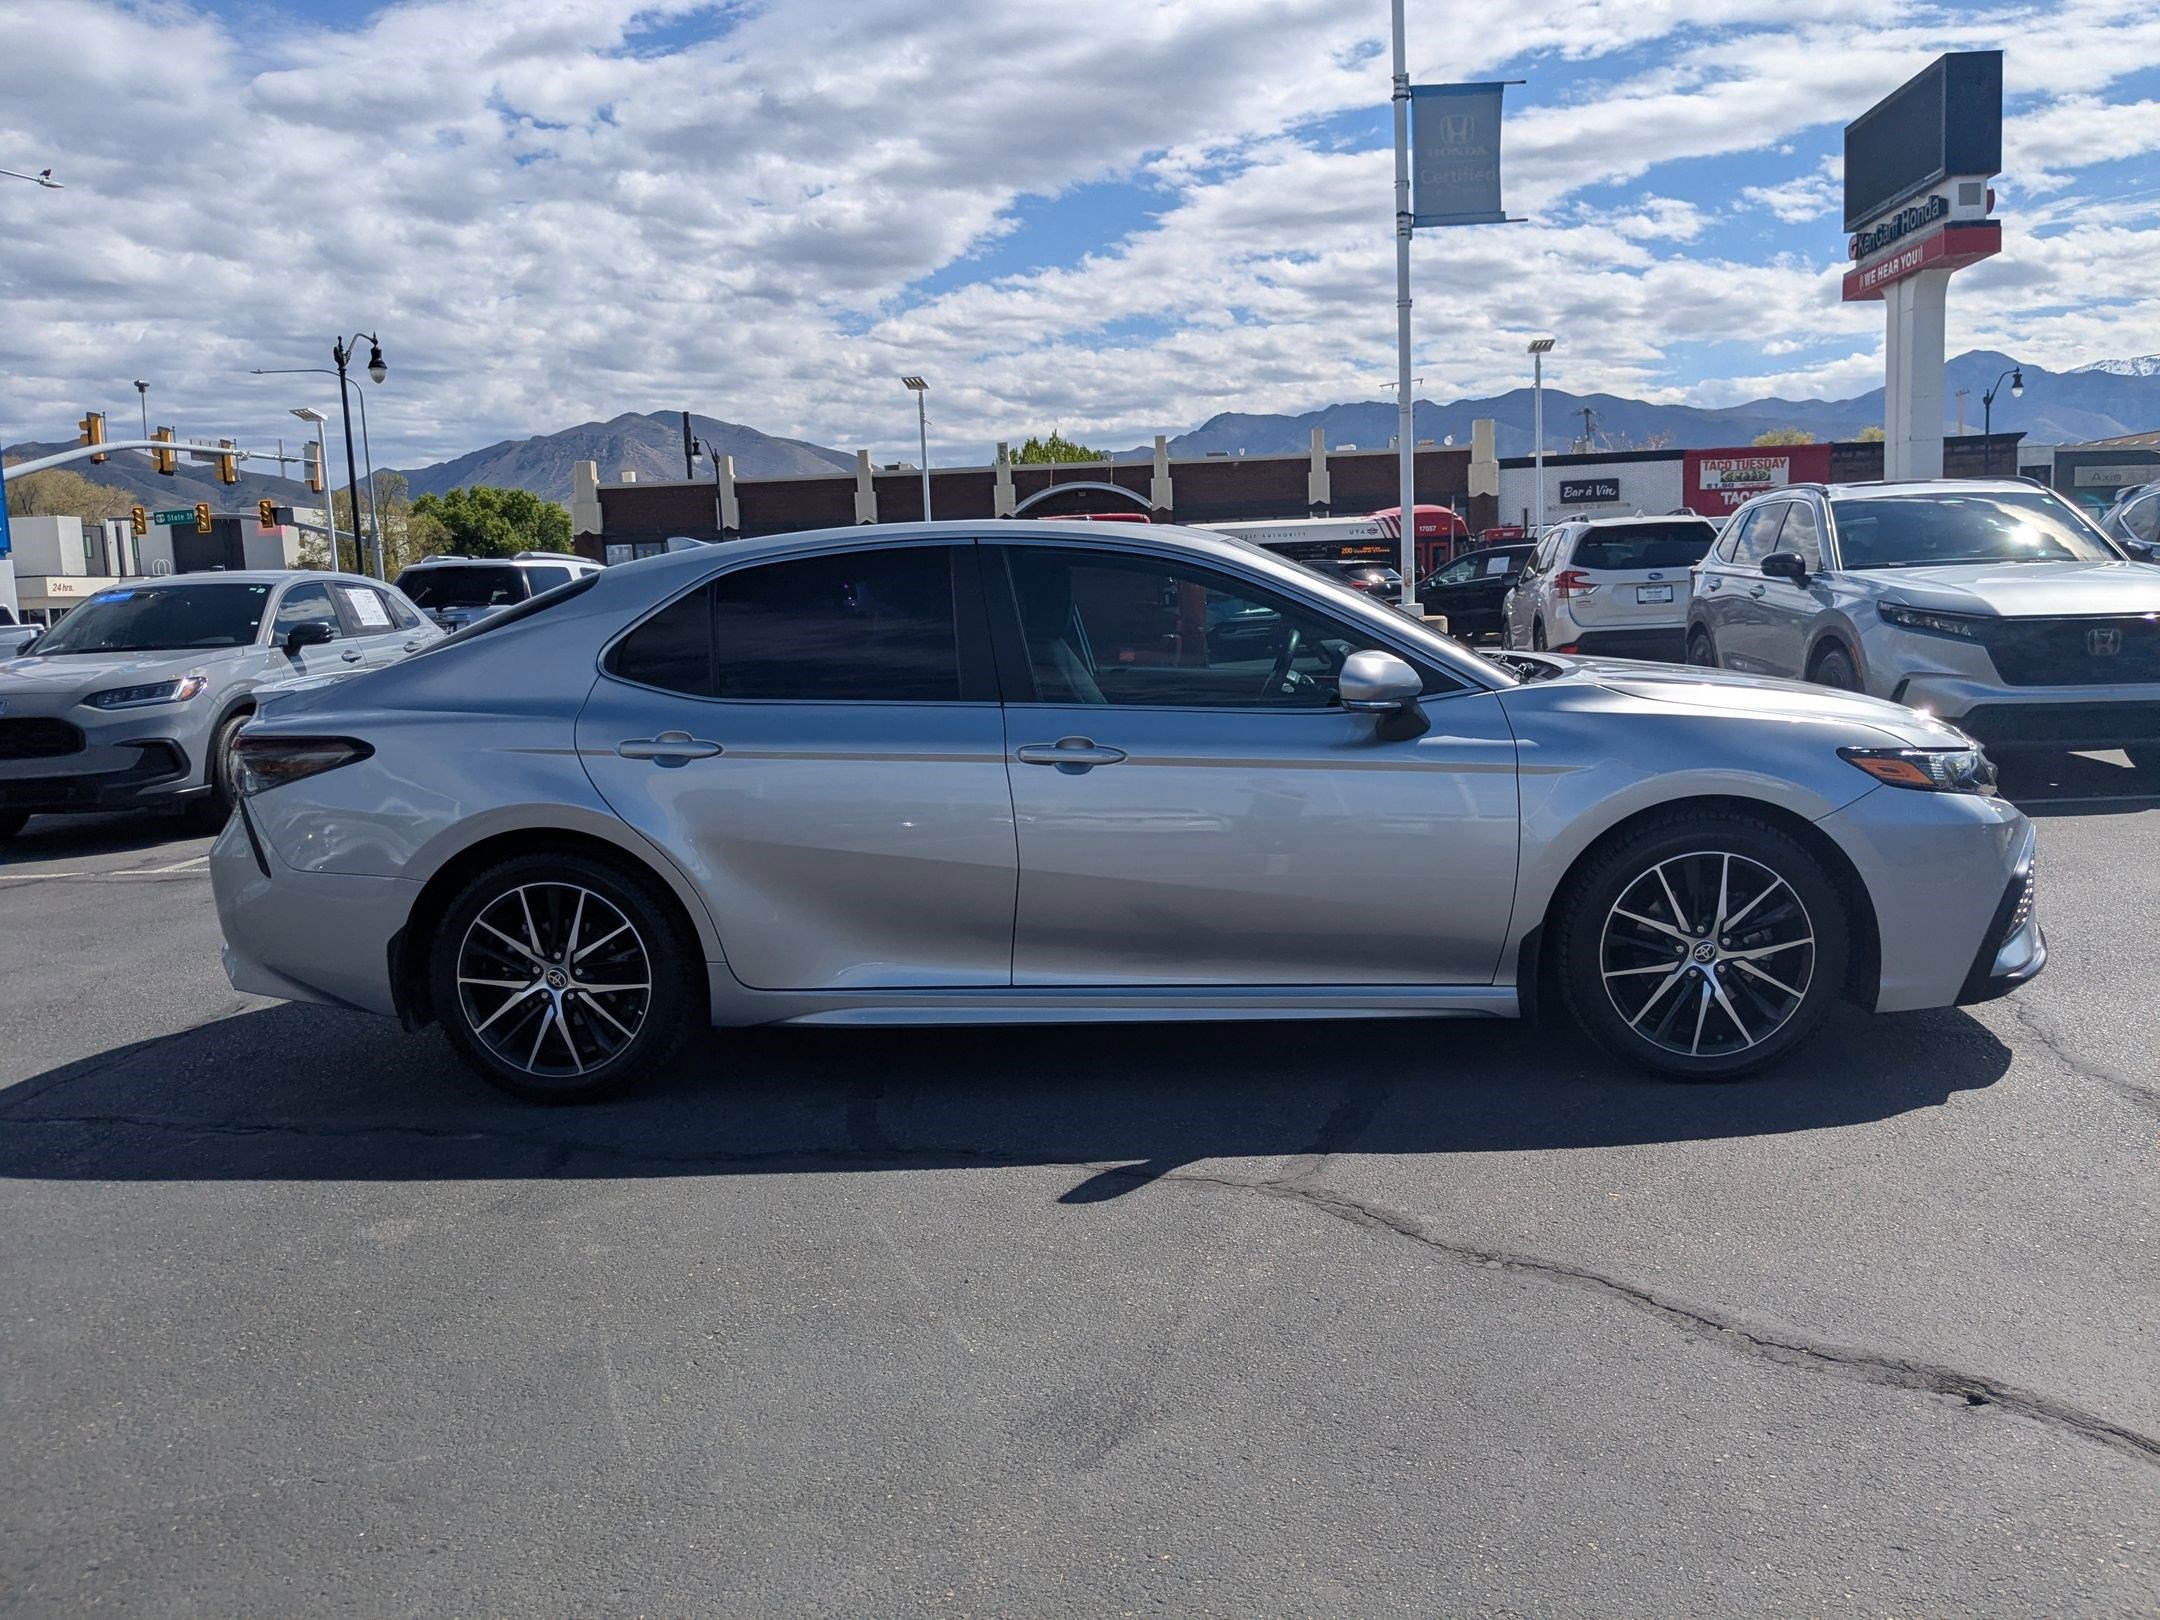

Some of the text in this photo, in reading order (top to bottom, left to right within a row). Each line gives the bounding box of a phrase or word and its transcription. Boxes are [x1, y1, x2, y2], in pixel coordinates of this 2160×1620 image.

[1864, 249, 1918, 287] WE HEAR YOU
[1703, 458, 1787, 471] TACO TUESDAY
[1563, 486, 1584, 498] Bar
[167, 513, 185, 522] State
[186, 512, 194, 520] St
[1341, 547, 1353, 555] 200
[52, 583, 75, 592] 24 hrs.
